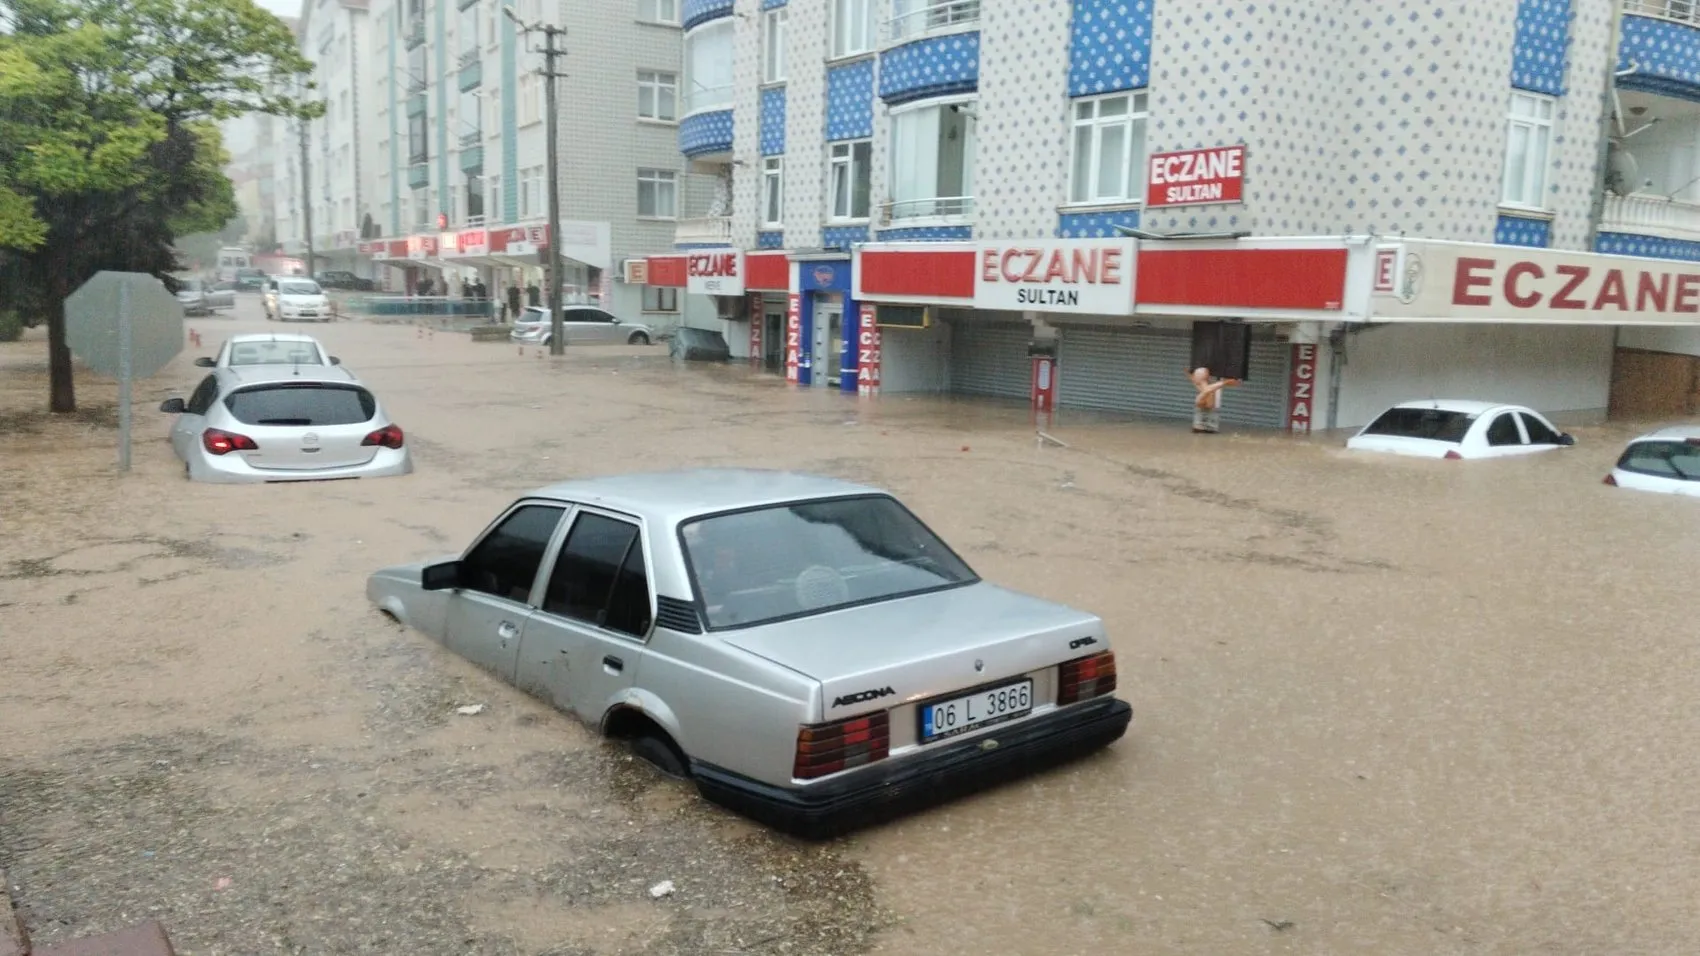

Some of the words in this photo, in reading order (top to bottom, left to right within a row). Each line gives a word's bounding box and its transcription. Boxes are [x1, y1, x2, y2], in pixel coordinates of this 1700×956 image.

[1150, 149, 1242, 184] ECZANE
[1166, 183, 1222, 203] SULTAN
[689, 252, 737, 277] ECZANE
[983, 247, 1122, 284] ECZANE
[1380, 258, 1392, 285] E
[1017, 288, 1079, 306] SULTAN
[1452, 257, 1700, 313] ECZANE
[1069, 635, 1098, 650] OPEL
[831, 686, 897, 709] ASCONA
[935, 704, 956, 730] 06
[967, 699, 977, 721] L
[987, 685, 1029, 715] 3866
